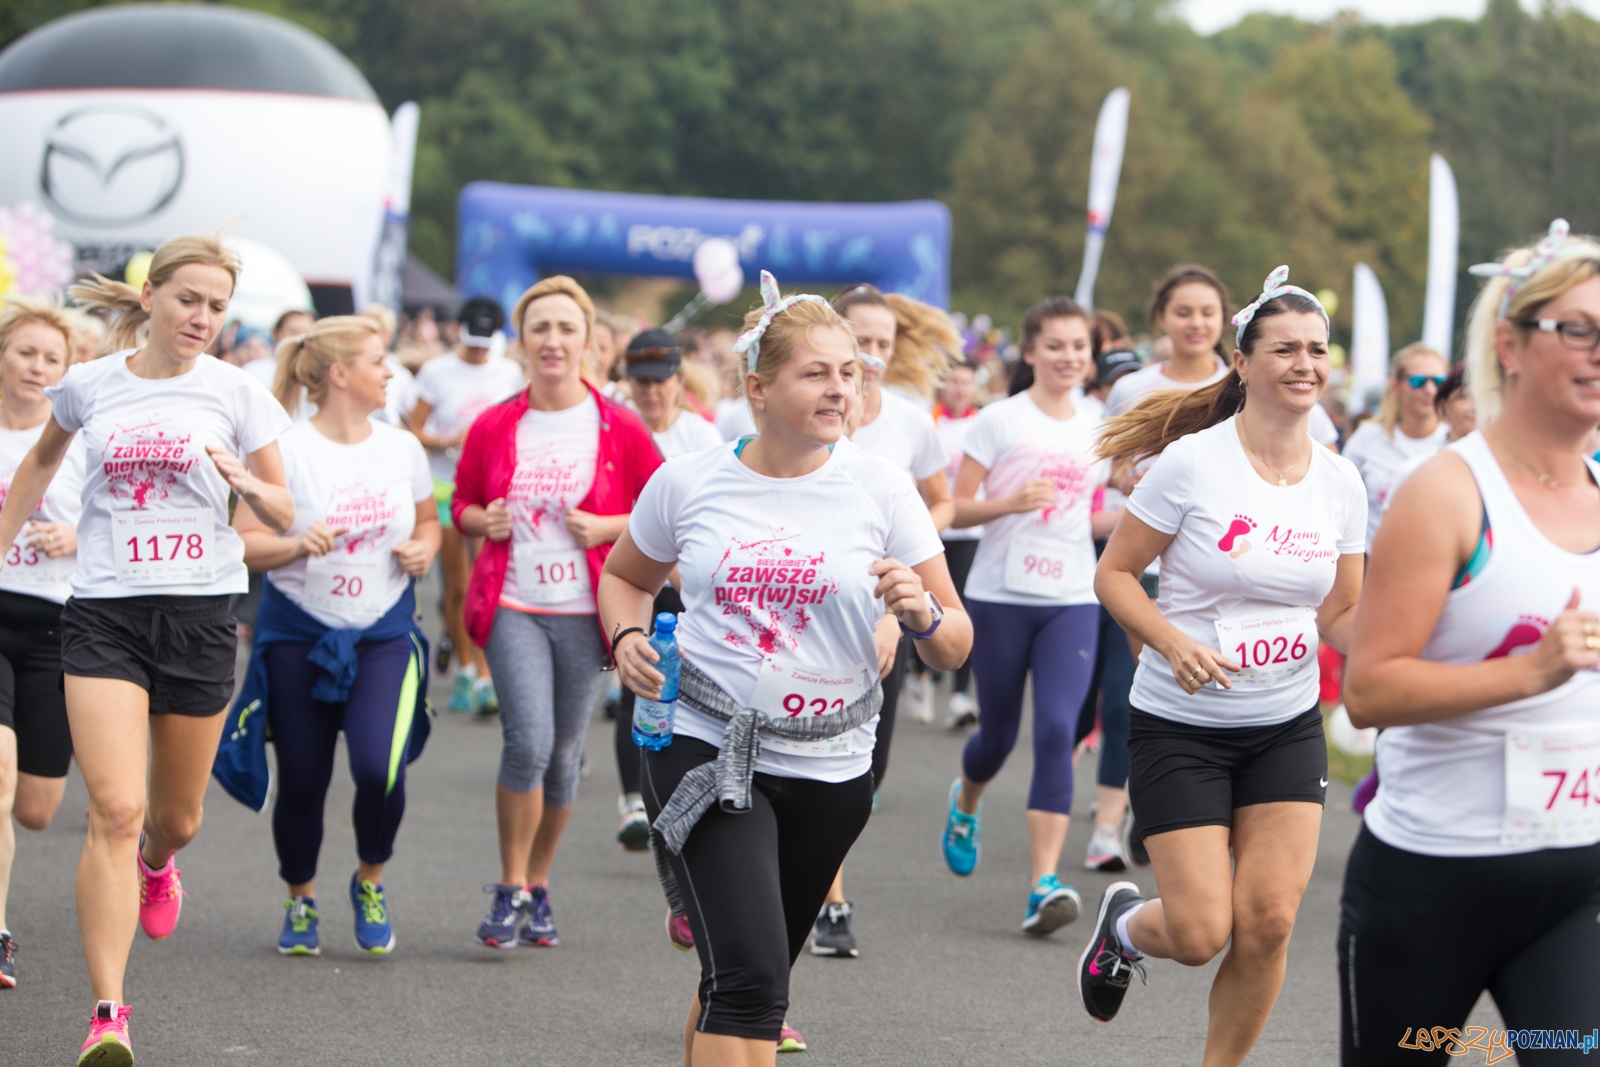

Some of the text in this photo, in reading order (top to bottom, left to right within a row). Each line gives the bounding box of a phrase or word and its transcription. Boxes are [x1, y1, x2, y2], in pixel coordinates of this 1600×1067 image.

[112, 445, 184, 459] zawsze
[1264, 525, 1321, 546] Mamy
[126, 533, 204, 563] 1178
[534, 560, 579, 585] 101
[756, 558, 807, 568] BIEG KOBIET
[1023, 554, 1064, 580] 908
[329, 574, 364, 598] 20
[725, 566, 817, 585] zawsze
[722, 602, 752, 617] 2016
[1235, 632, 1308, 669] 1026
[791, 671, 818, 684] Zawsze
